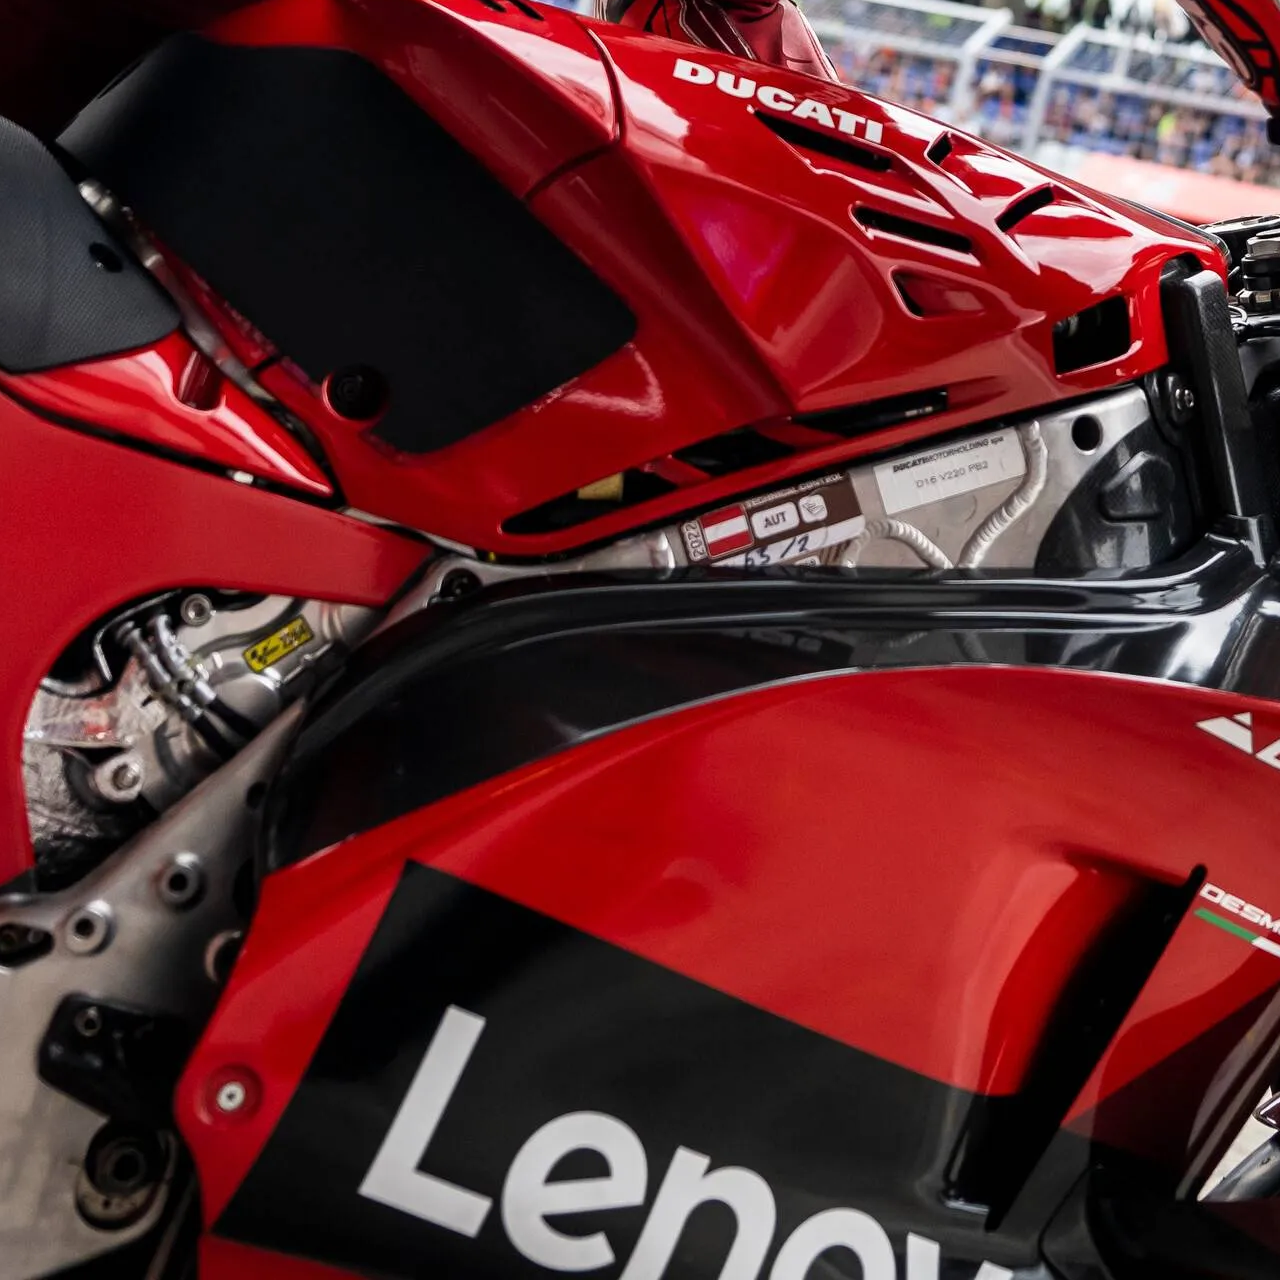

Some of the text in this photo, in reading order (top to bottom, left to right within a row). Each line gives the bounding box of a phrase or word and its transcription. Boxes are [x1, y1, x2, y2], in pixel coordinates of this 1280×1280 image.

[673, 58, 883, 144] DUCATI
[683, 519, 706, 561] 2022
[763, 510, 788, 529] AUT
